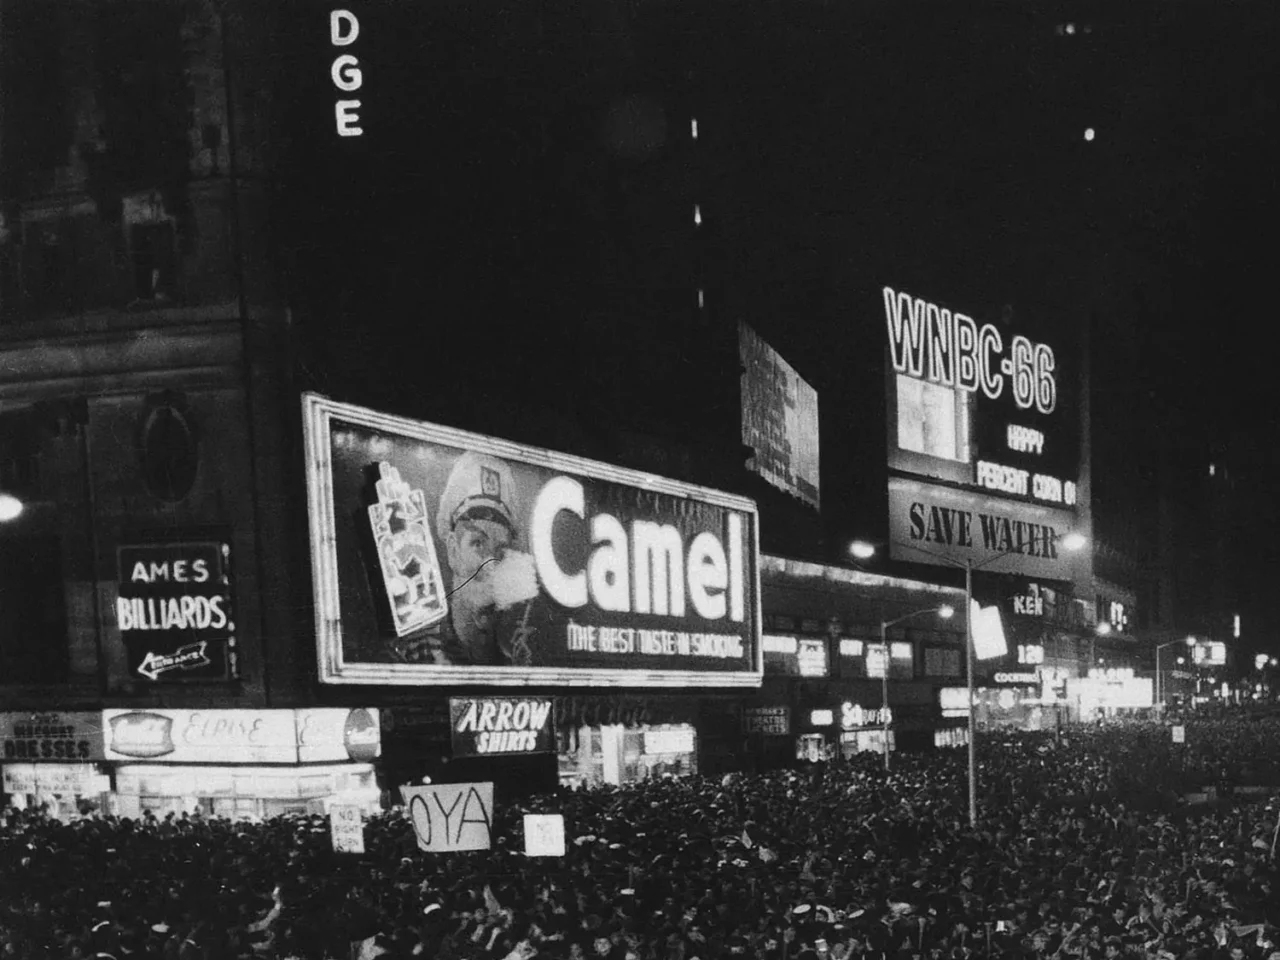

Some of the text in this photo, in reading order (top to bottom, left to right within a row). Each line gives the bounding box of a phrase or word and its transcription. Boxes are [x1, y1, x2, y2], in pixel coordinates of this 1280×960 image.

[330, 9, 364, 137] DGE
[883, 286, 1056, 414] WNBC-66
[1006, 424, 1044, 454] HAPPY
[977, 460, 1030, 496] PERCENT
[532, 476, 744, 622] Camel
[910, 502, 1058, 560] SAVE WATER
[131, 559, 209, 583] AMES
[117, 595, 227, 631] BILLIARDS
[567, 623, 597, 652] THE
[600, 626, 633, 653] BEST
[457, 700, 552, 733] ARROW
[475, 731, 537, 753] SHIRTS
[410, 786, 492, 845] OYA
